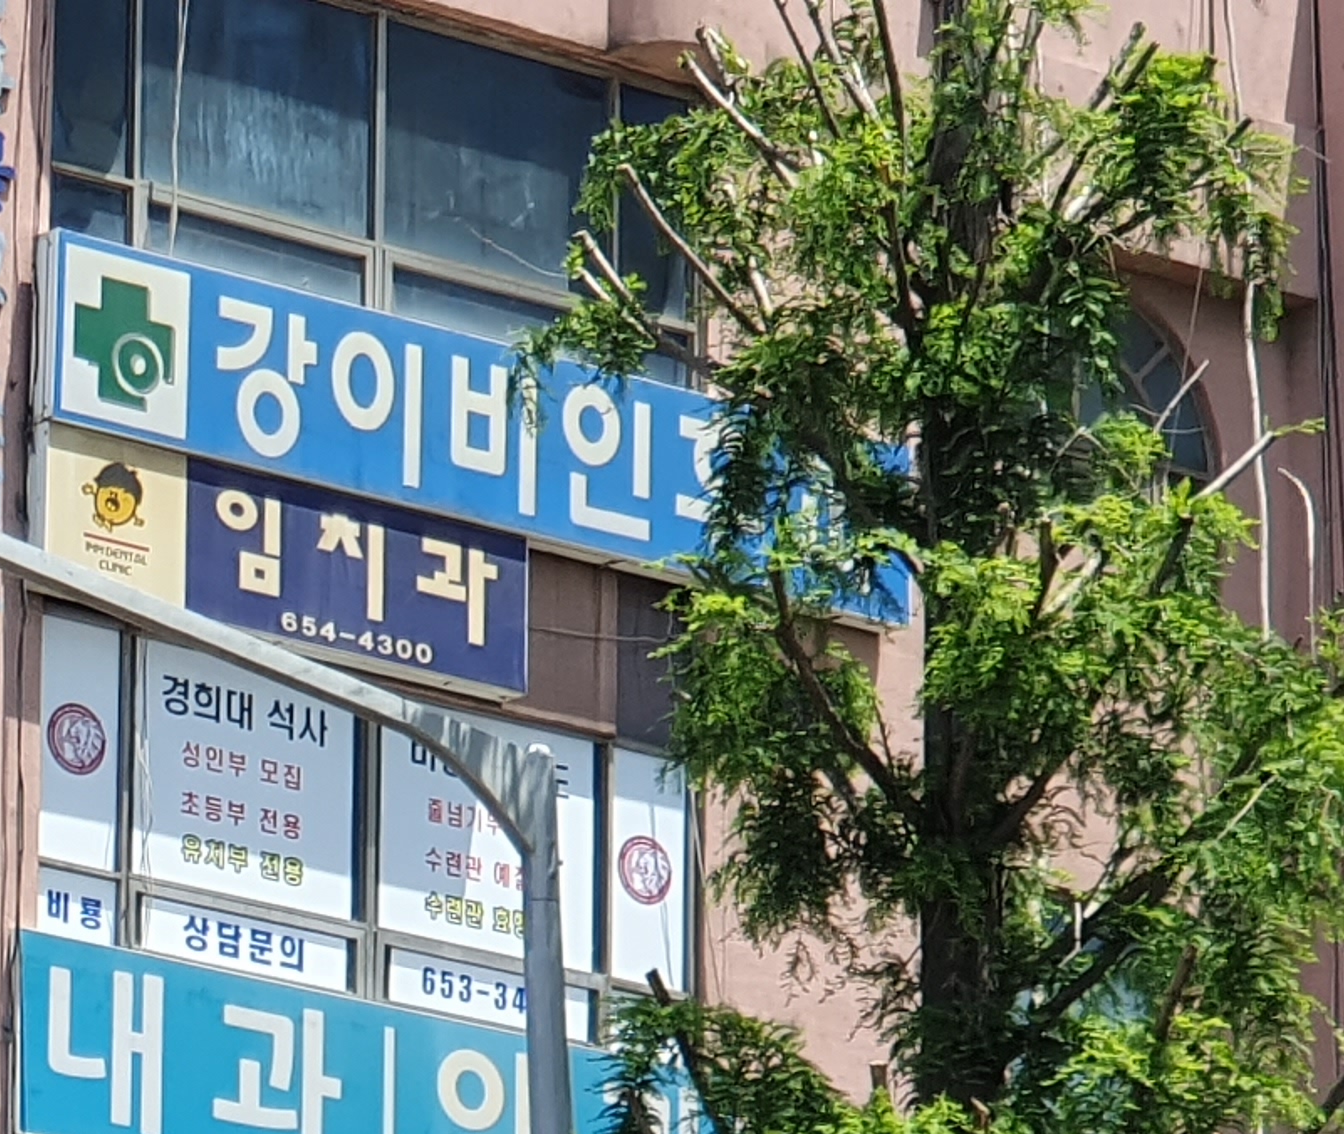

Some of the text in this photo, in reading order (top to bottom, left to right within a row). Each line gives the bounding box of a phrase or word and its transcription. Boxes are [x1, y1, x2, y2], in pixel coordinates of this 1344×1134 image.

[215, 489, 499, 647] 임치과
[280, 610, 435, 665] 654-4300
[161, 674, 329, 747] 경희대 석사
[181, 740, 304, 792] 성인부 모집
[180, 791, 303, 841] 초등부 전용
[259, 849, 305, 887] 전용
[424, 846, 483, 883] 수련관
[424, 890, 485, 930] 수련관
[182, 914, 306, 973] 상담문의
